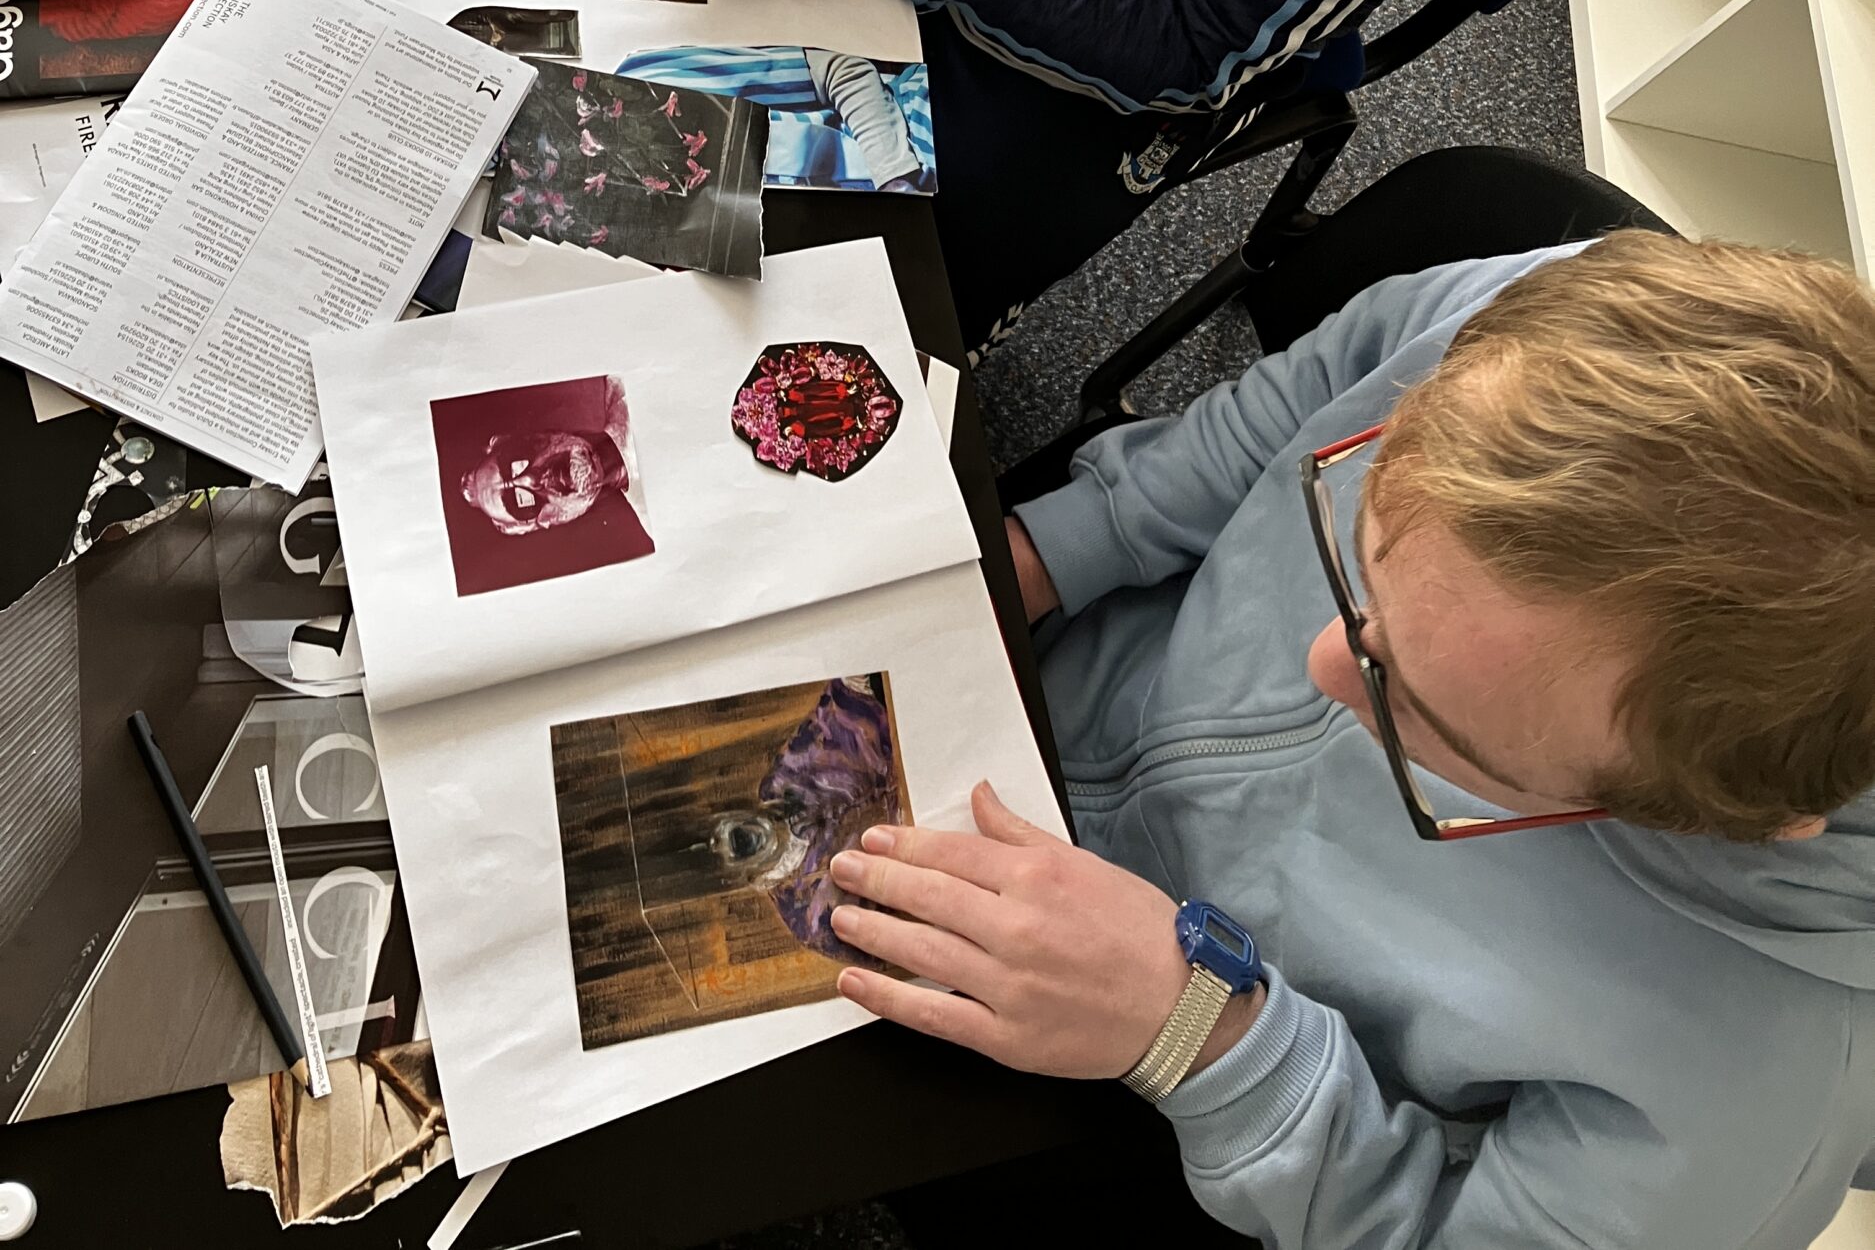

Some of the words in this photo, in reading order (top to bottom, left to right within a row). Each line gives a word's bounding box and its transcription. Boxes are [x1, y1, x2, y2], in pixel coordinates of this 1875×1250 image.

[233, 0, 251, 19] THE
[75, 115, 97, 158] FIRE
[126, 207, 155, 224] IRELAND
[289, 937, 301, 968] created
